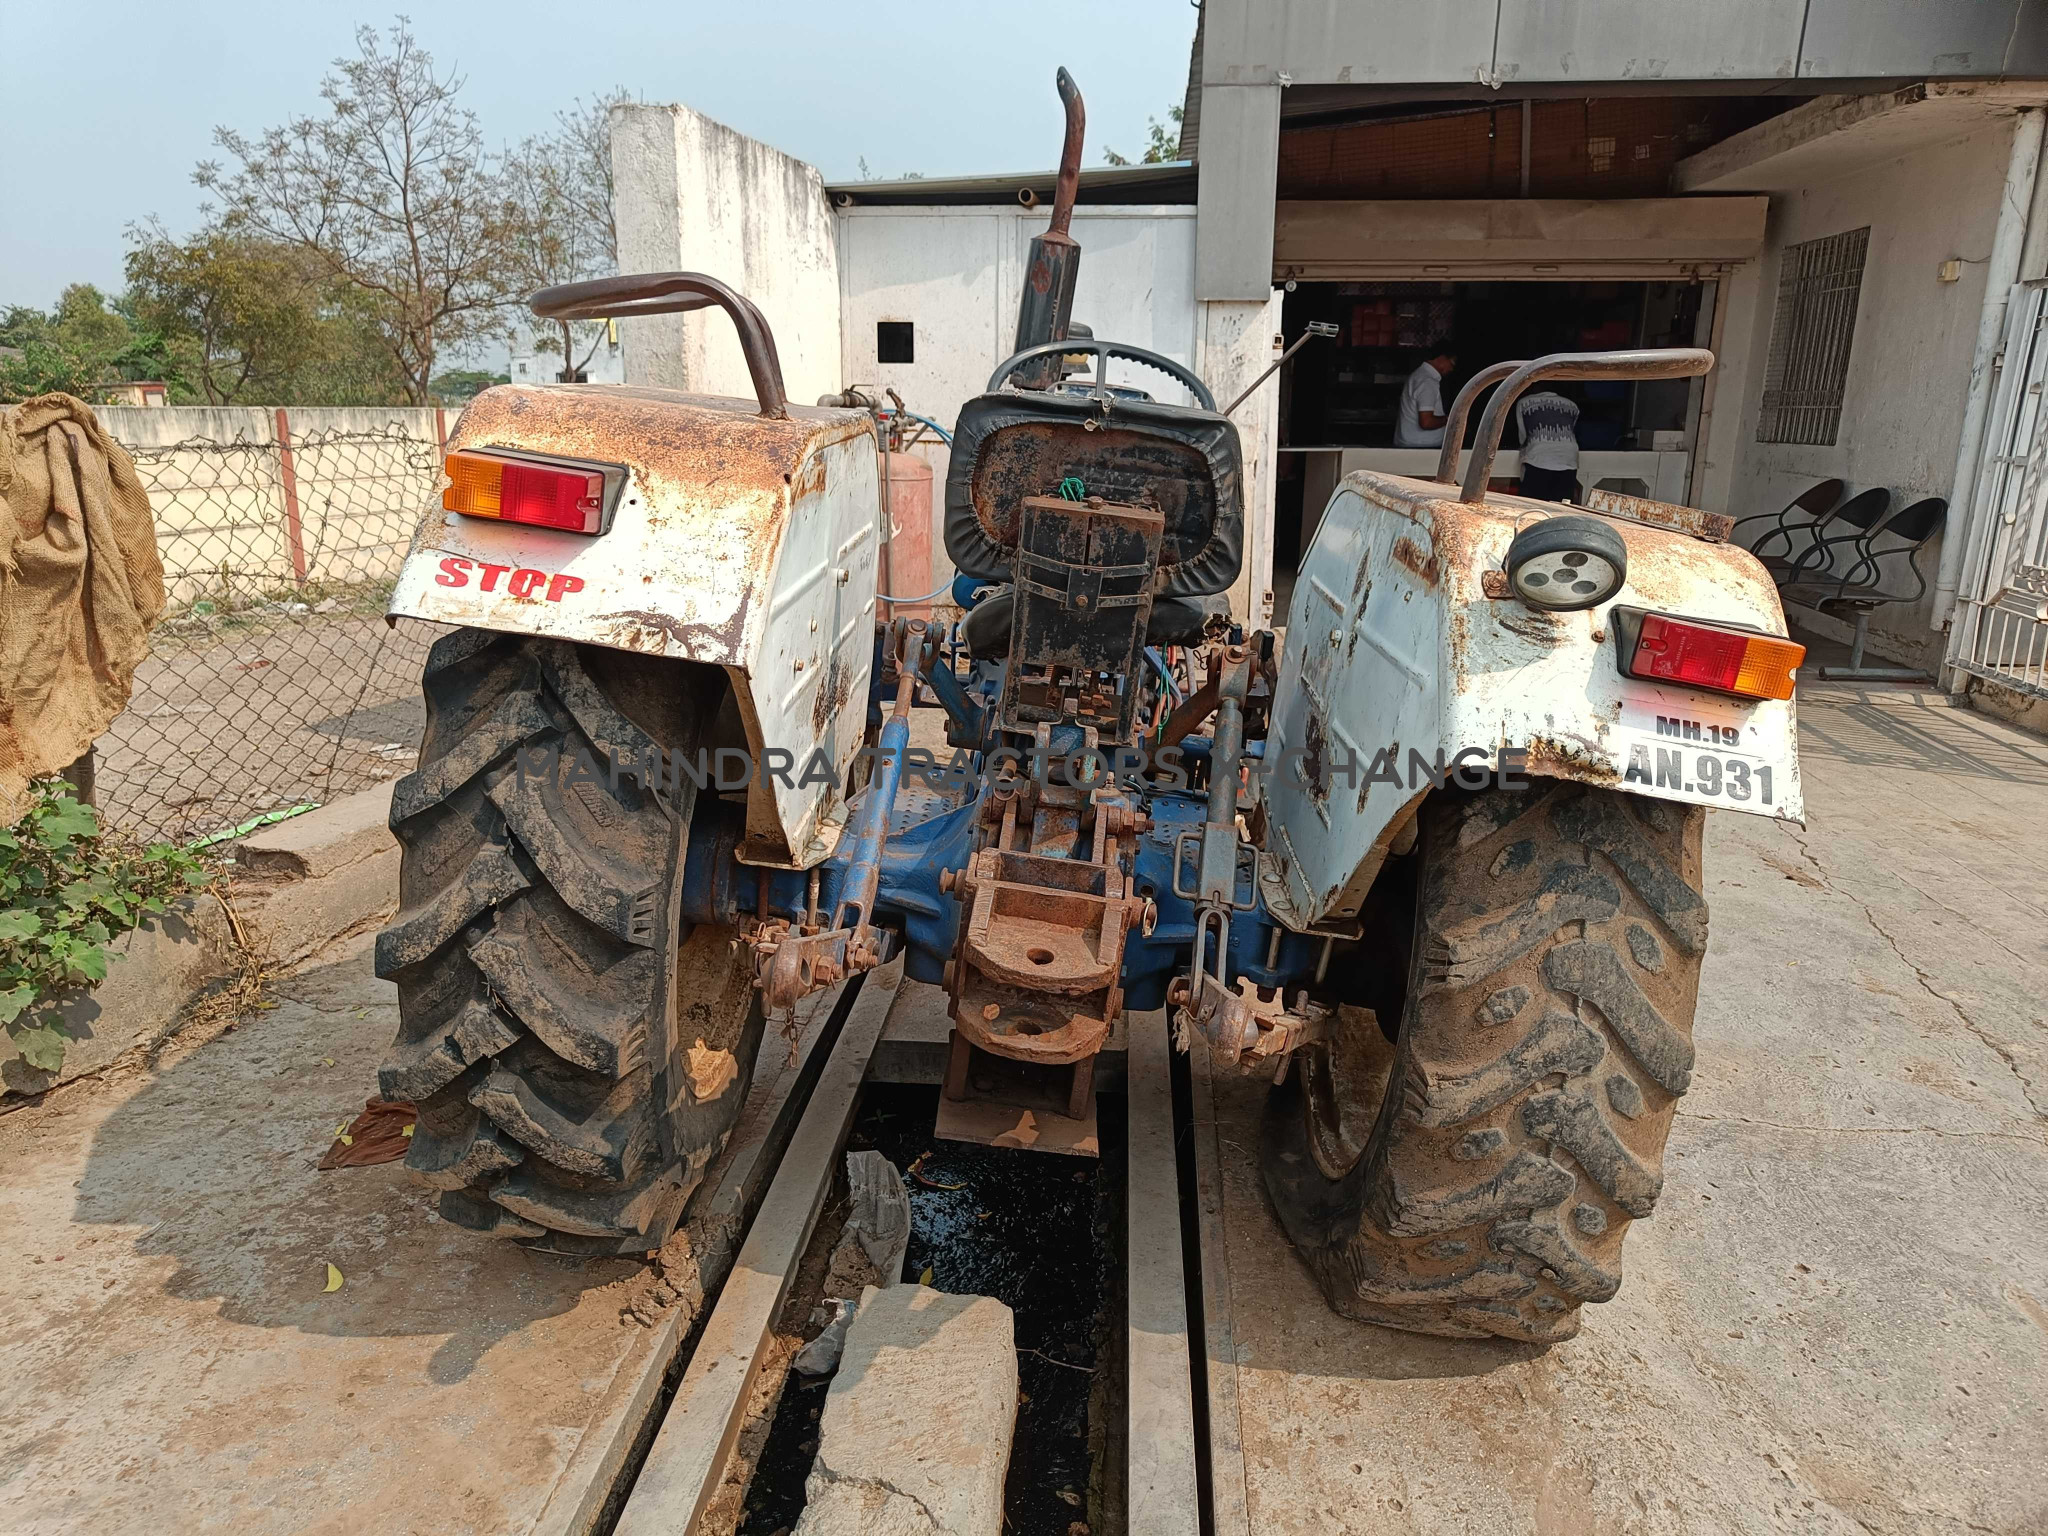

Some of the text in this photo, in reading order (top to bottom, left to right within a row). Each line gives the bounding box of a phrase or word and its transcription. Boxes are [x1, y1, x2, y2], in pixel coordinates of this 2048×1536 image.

[435, 557, 585, 603] STOP
[1656, 715, 1740, 747] MH.19
[1624, 743, 1773, 806] AN.931
